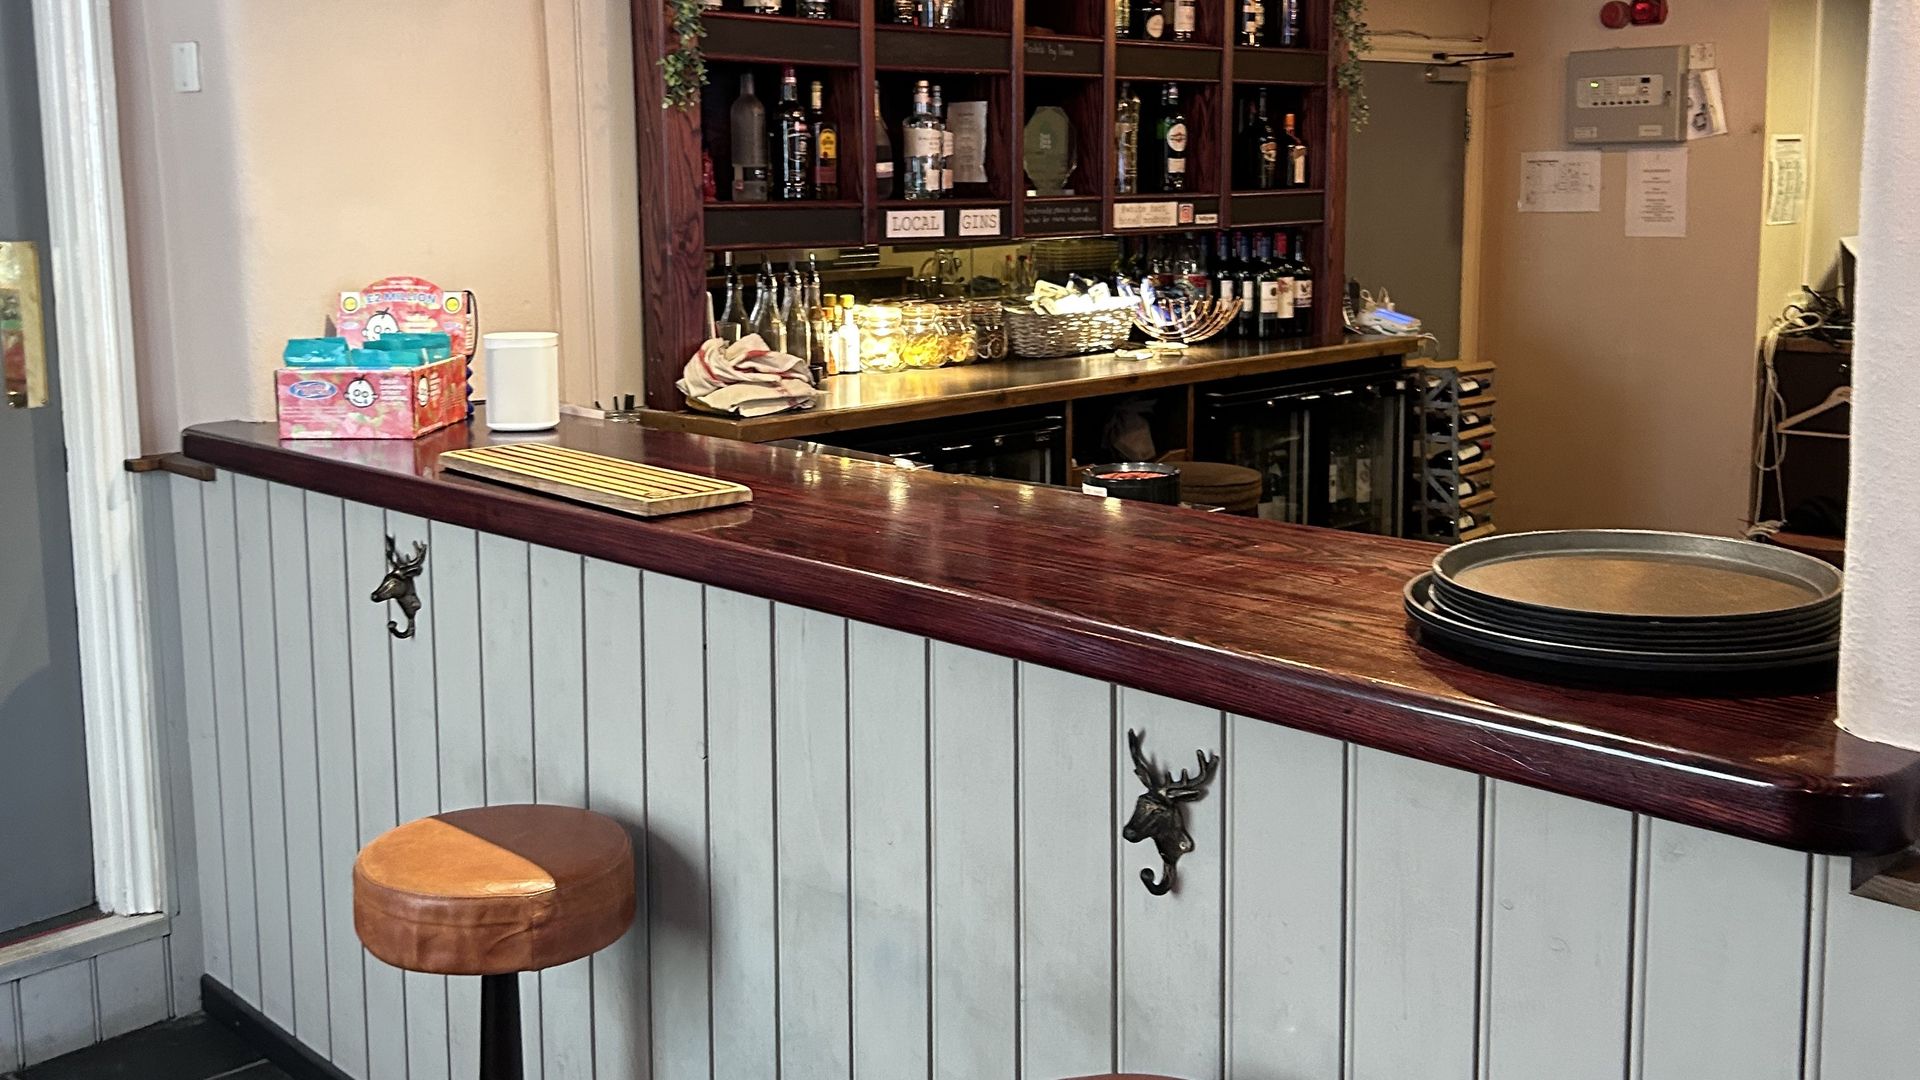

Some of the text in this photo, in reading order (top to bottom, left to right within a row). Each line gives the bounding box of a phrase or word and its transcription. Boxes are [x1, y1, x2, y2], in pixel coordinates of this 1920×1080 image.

[891, 214, 998, 231] LOCAL GINS
[383, 291, 436, 305] MILLION
